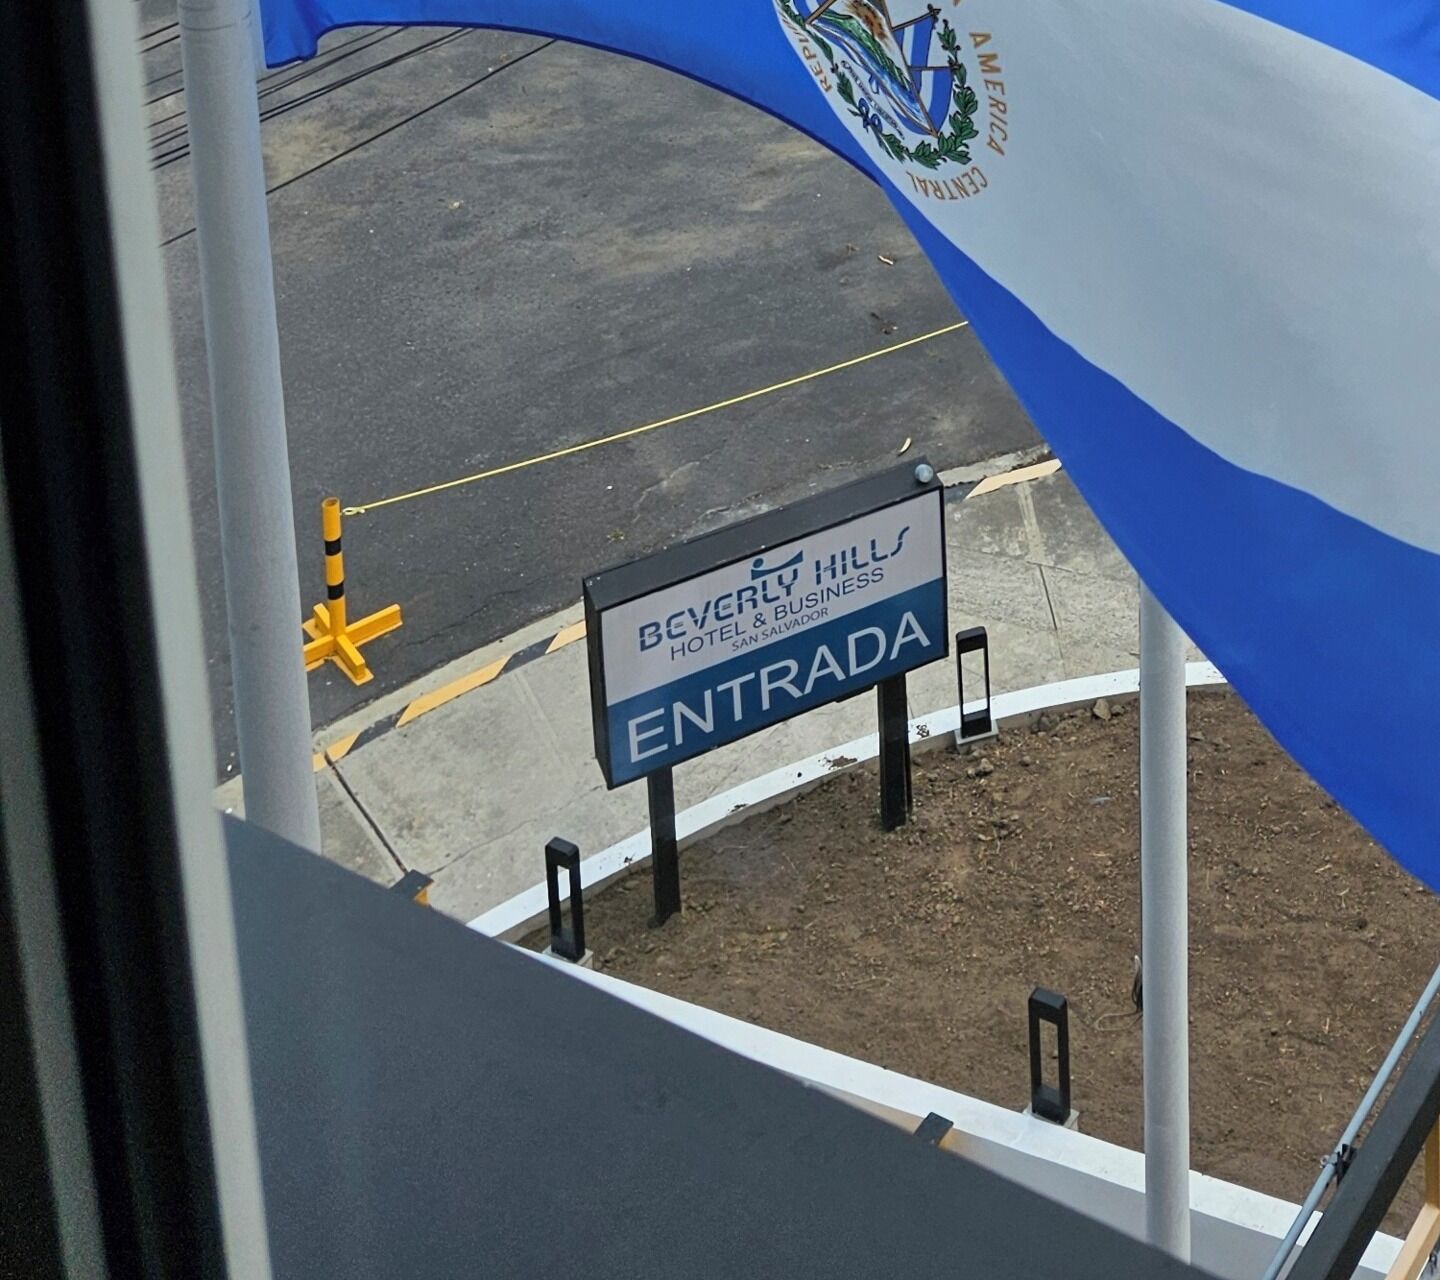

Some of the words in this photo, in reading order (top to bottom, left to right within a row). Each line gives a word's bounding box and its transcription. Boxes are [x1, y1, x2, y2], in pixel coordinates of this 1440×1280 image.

[969, 31, 1009, 156] AMERICA
[905, 165, 989, 201] CENTRAL
[639, 568, 799, 652] BEVERLY
[815, 526, 910, 586] HILLS
[670, 621, 747, 661] HOTEL
[753, 612, 767, 629] &
[774, 567, 884, 622] BUSINESS
[731, 634, 759, 652] SAN
[761, 606, 829, 640] SALVADOR
[627, 610, 932, 764] ENTRADA
